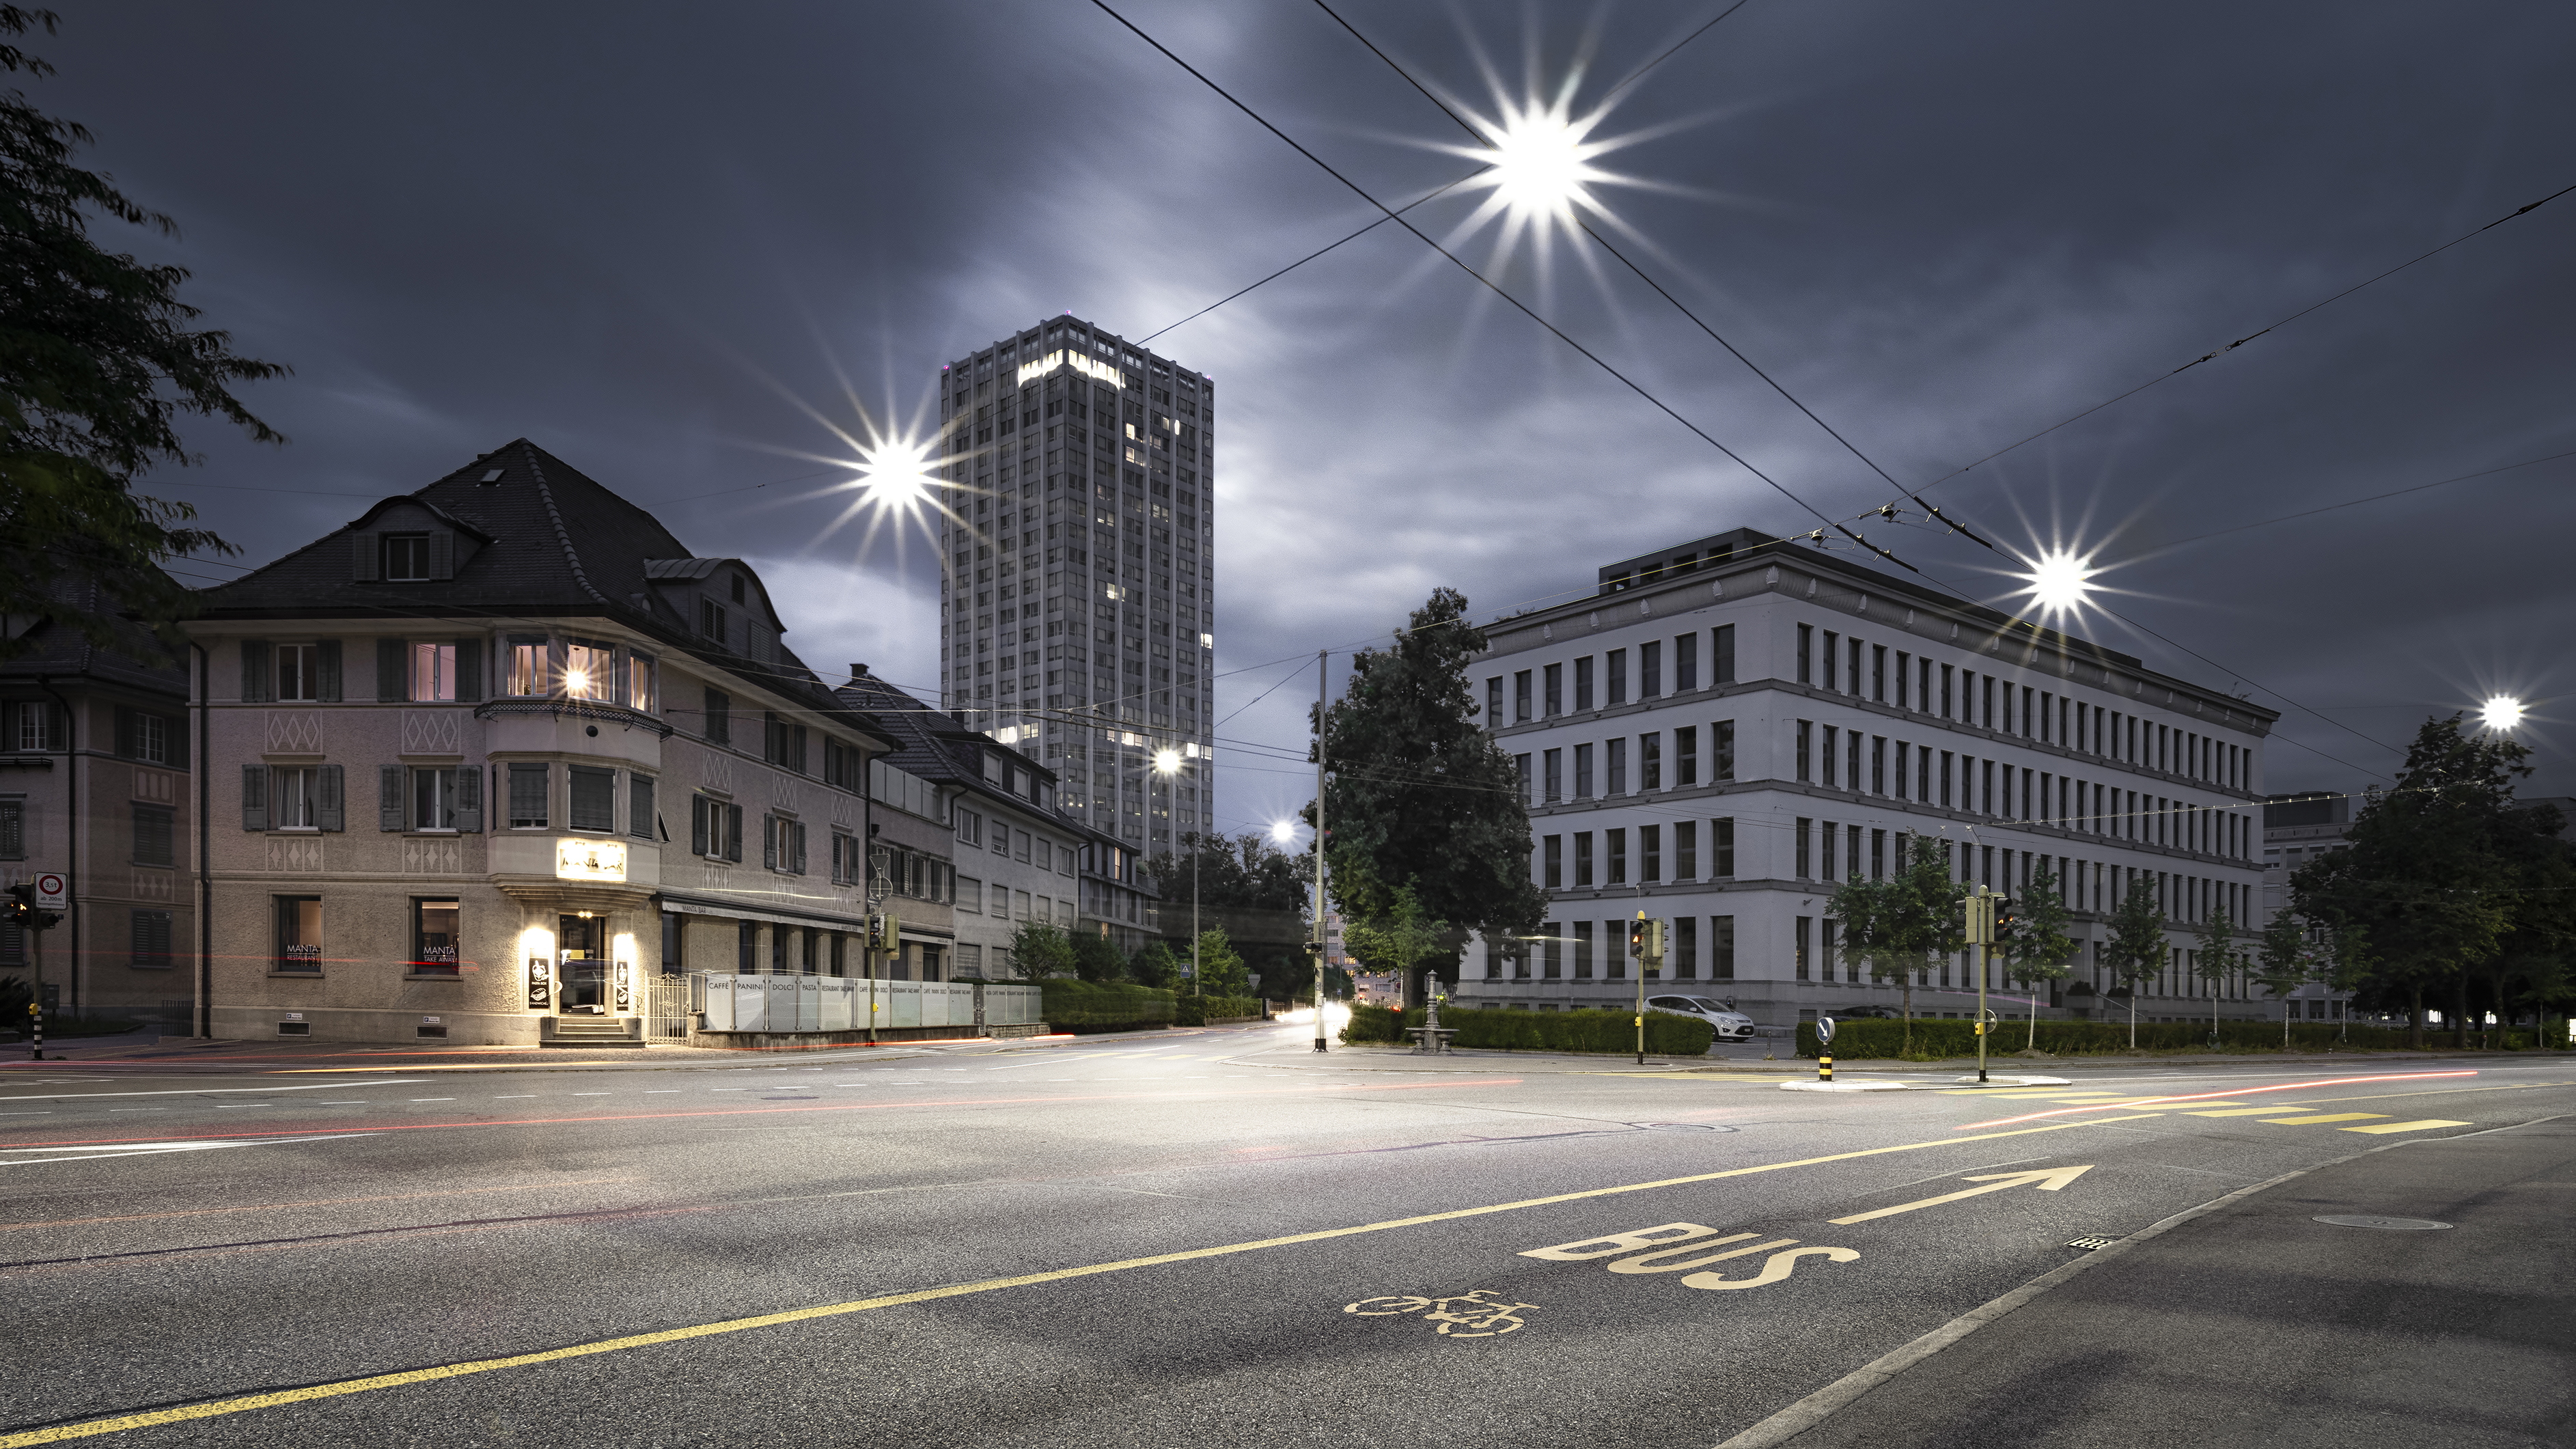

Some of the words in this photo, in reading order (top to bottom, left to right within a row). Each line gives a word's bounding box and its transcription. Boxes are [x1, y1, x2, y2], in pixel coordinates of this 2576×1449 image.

[287, 944, 318, 952] MANTA
[424, 946, 456, 954] MANTA
[1516, 1222, 1861, 1290] BUS
